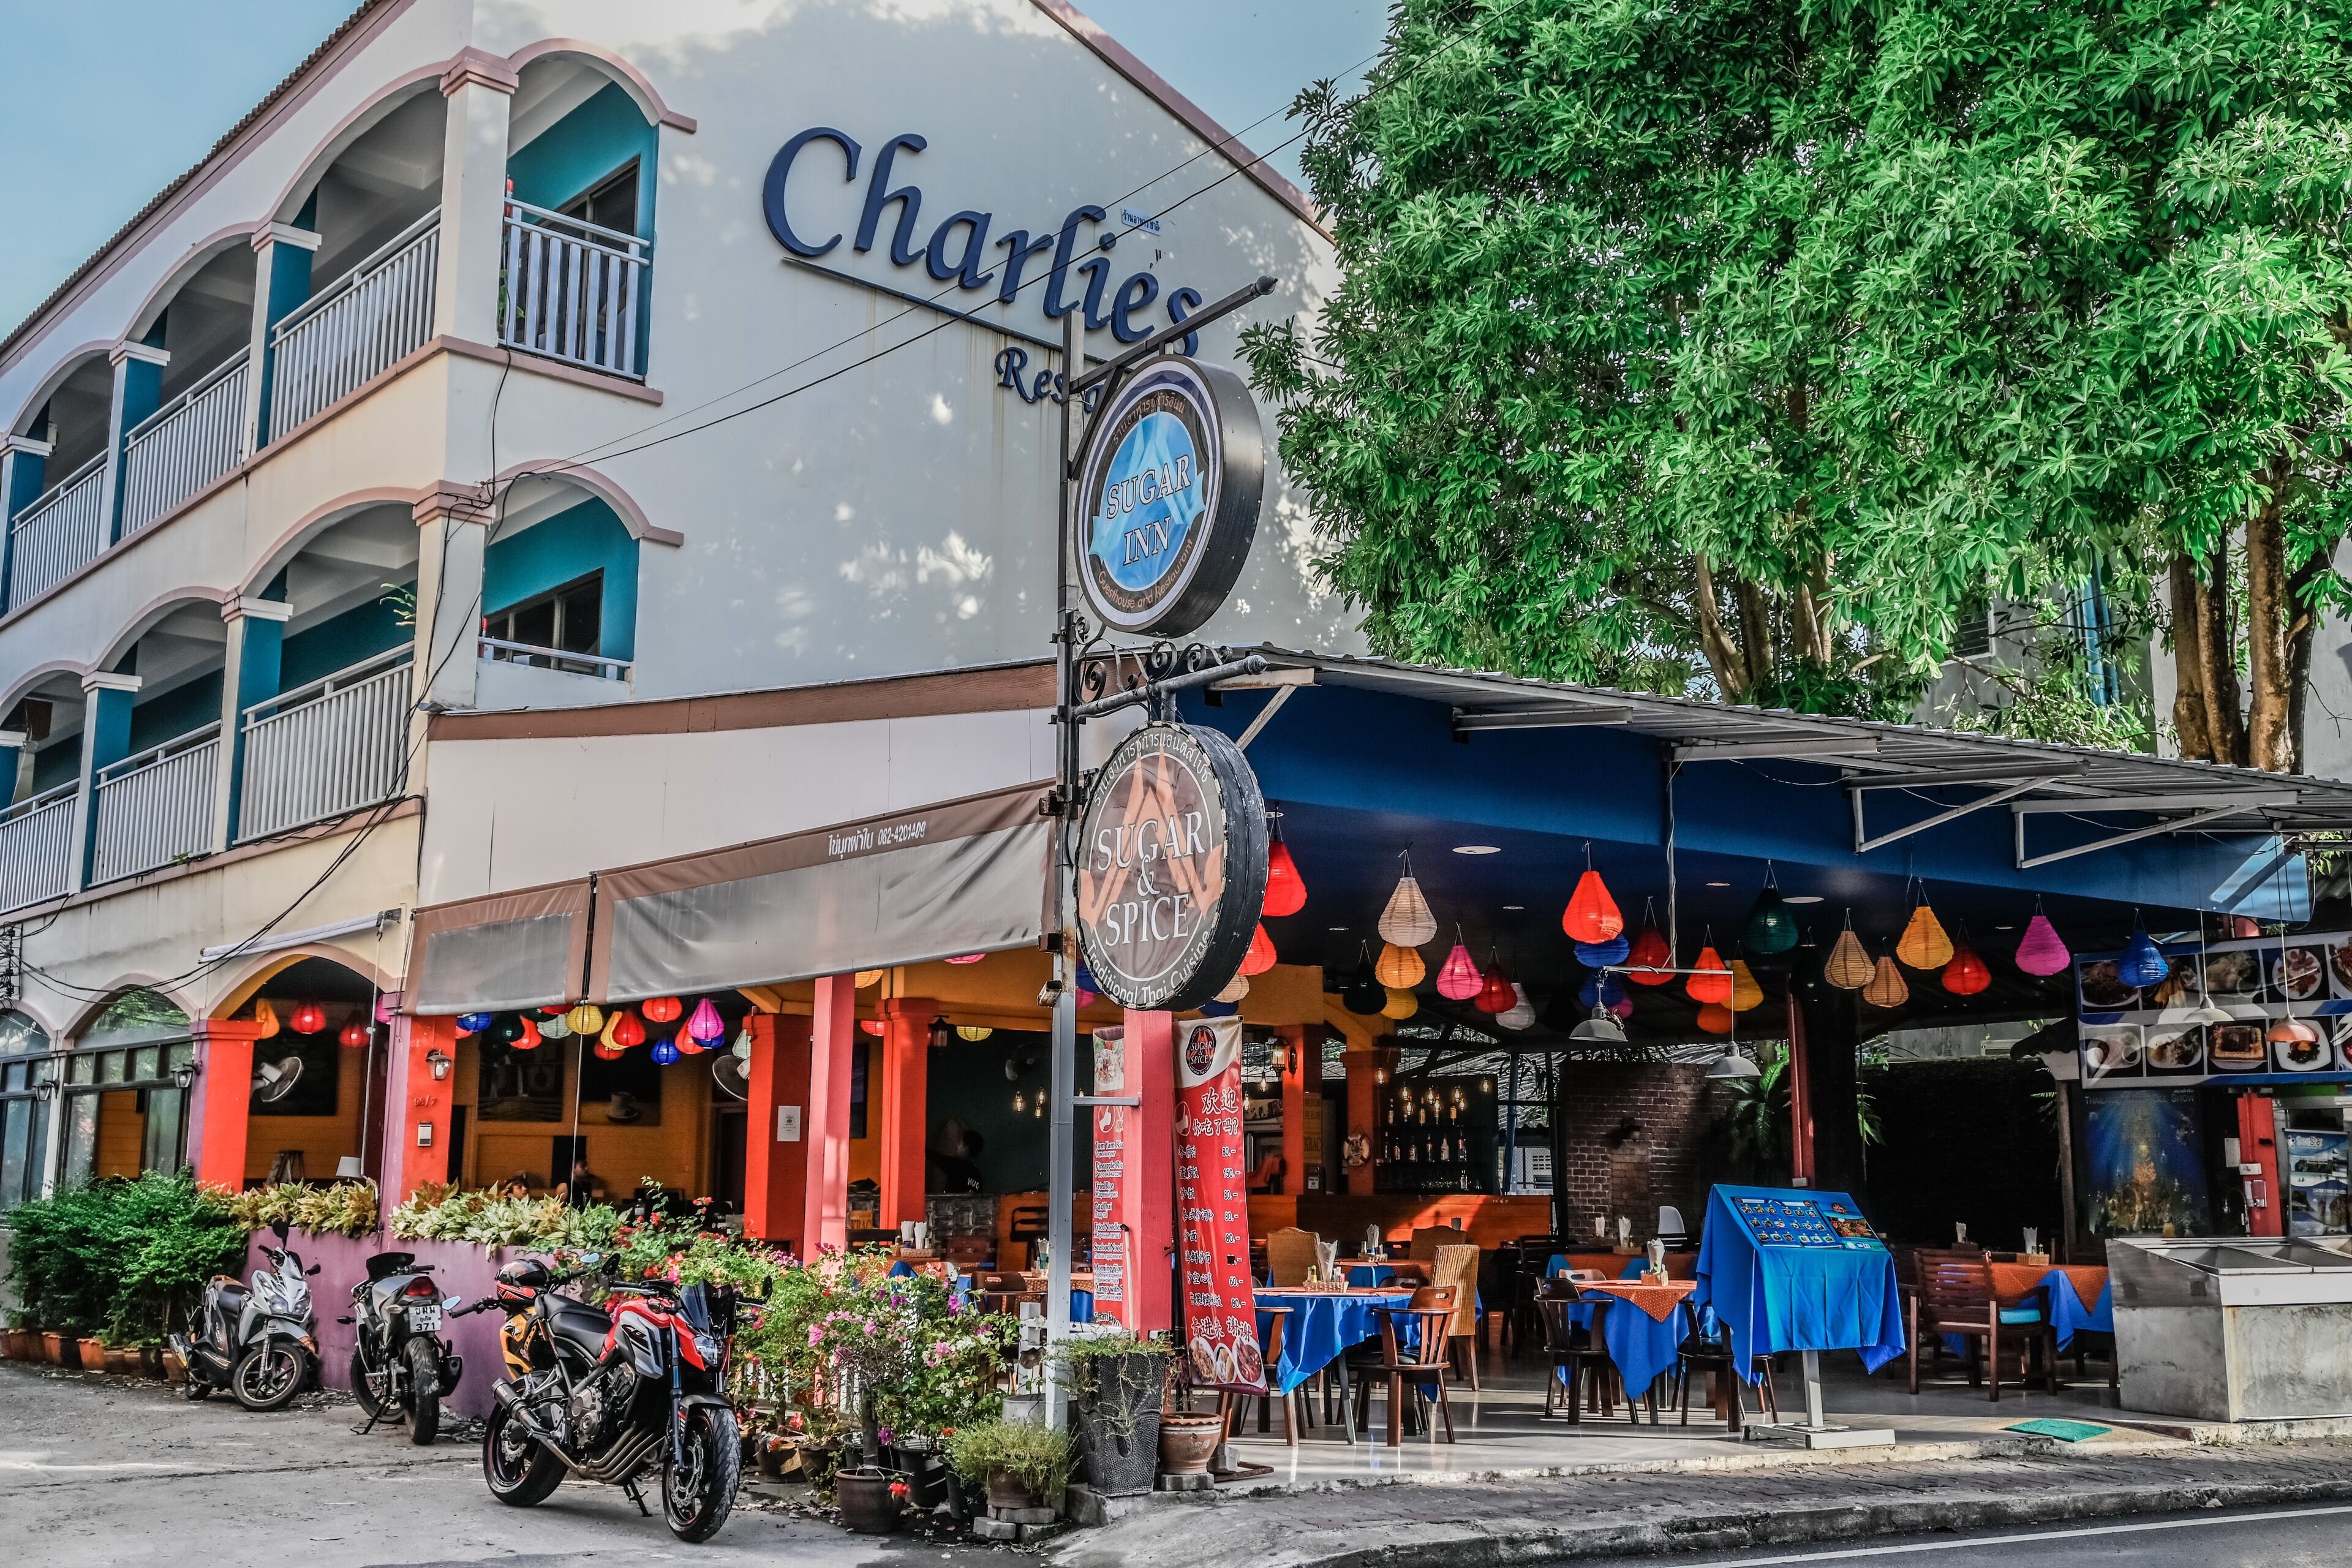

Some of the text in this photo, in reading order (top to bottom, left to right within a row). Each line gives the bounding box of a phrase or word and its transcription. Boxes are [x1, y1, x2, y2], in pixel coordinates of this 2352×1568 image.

[1106, 454, 1191, 520] SUGAR
[1123, 516, 1170, 567] INN
[1098, 538, 1193, 608] Guesthouse and Restaurant
[1097, 810, 1205, 872] SUGAR
[1137, 854, 1161, 897] &
[1105, 893, 1190, 947] SPICE
[1087, 930, 1211, 1005] Traditional Thai Cuisine
[1190, 1055, 1209, 1065] SPICE
[1191, 1041, 1213, 1052] SUGAR
[1201, 1087, 1239, 1114] 欢迎
[1192, 1118, 1238, 1136] 你吃了吗?
[1115, 1140, 1124, 1149] Ku
[1110, 1242, 1123, 1252] Nood
[1112, 1264, 1123, 1273] Glor
[416, 1322, 435, 1331] 371
